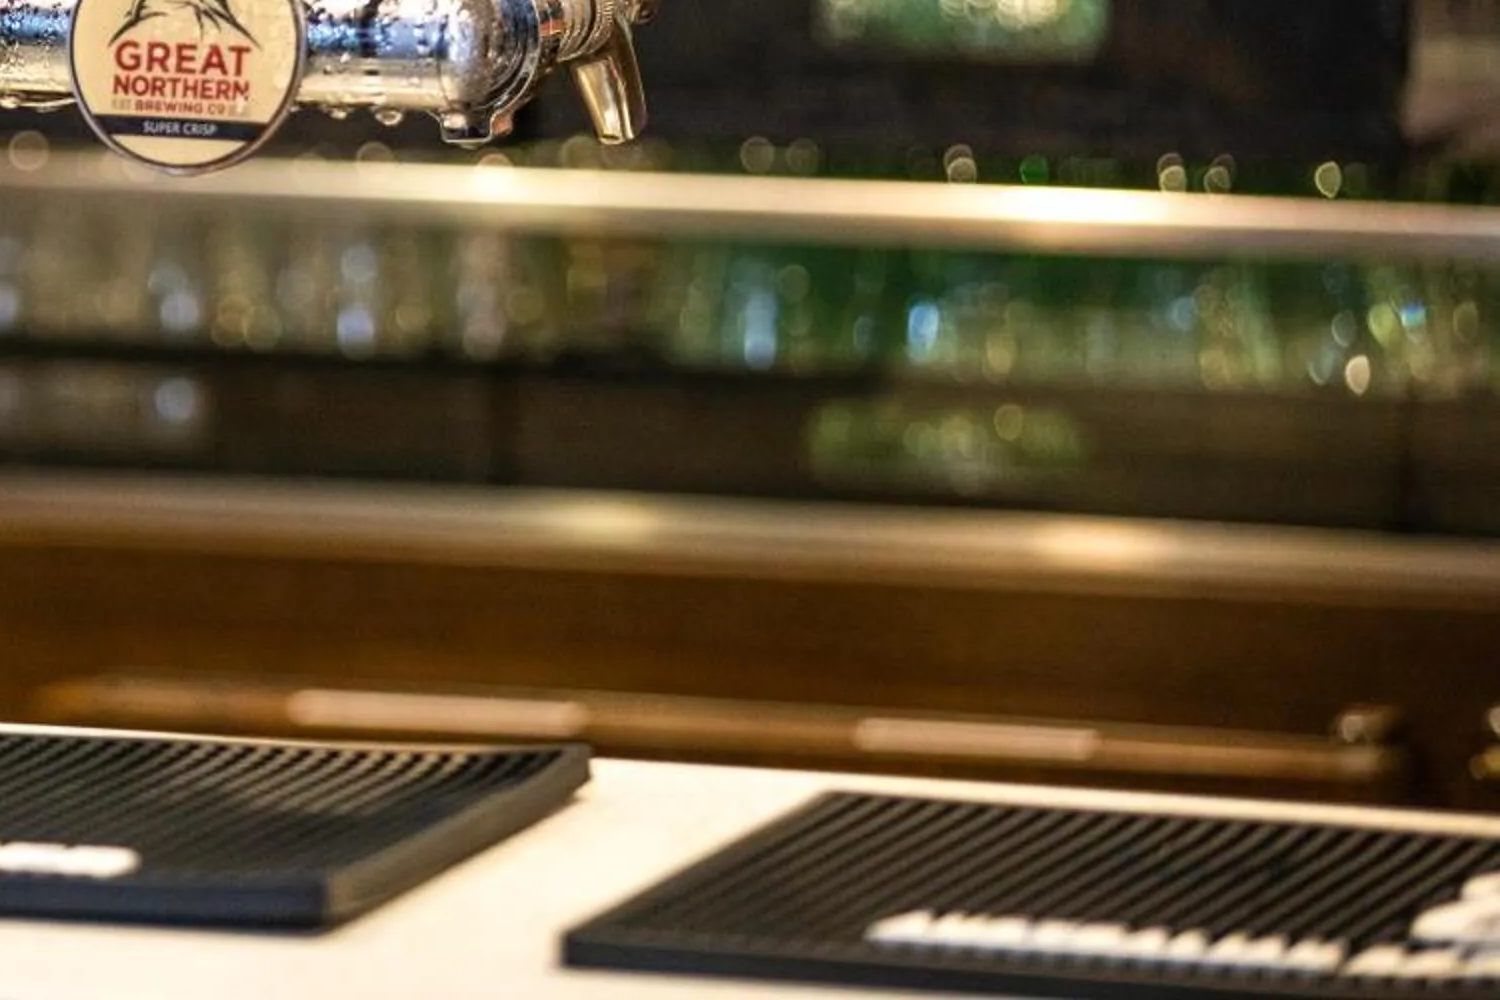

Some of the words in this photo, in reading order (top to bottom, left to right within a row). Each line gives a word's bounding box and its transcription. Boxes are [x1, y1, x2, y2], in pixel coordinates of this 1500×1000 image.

[114, 40, 253, 76] GREAT
[112, 74, 250, 101] NORTHERN
[135, 99, 203, 114] BREWING
[143, 120, 181, 134] SUPER
[183, 122, 218, 136] CRISP
